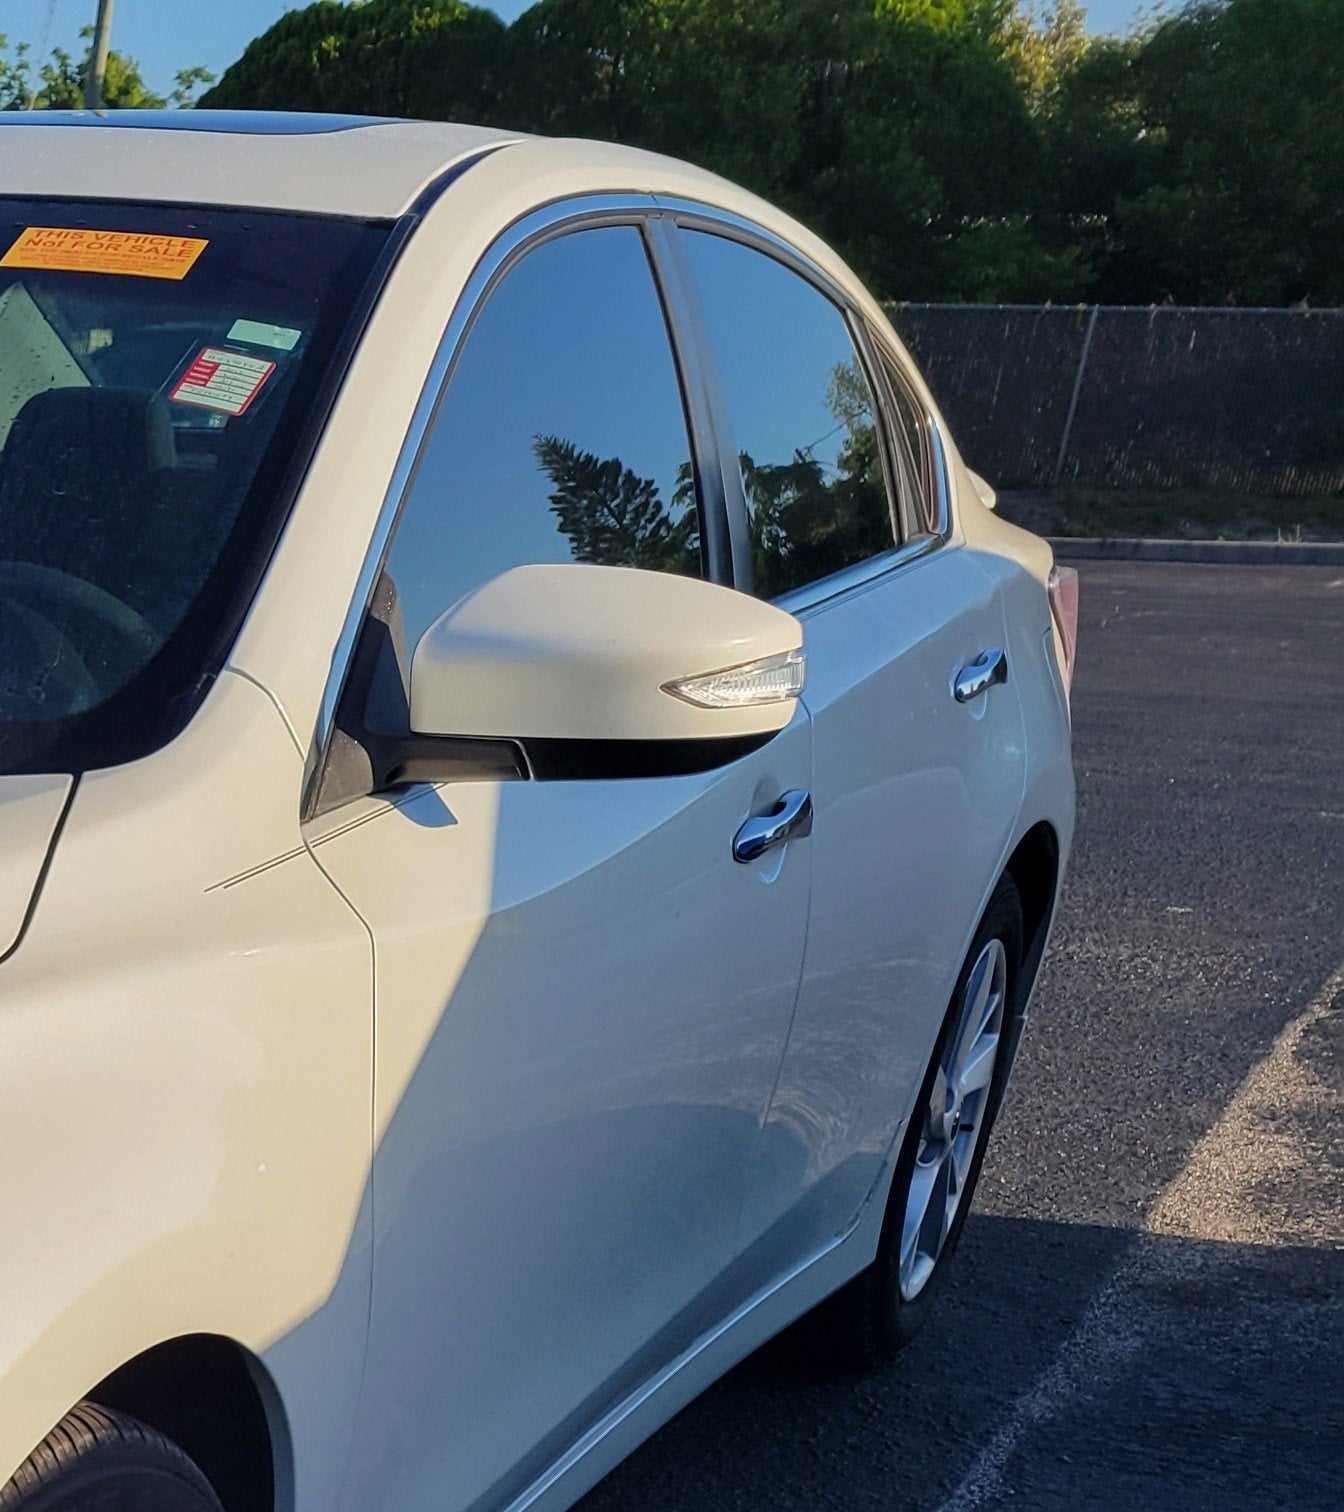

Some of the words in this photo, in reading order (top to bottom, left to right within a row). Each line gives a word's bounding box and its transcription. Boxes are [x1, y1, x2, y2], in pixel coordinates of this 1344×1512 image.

[33, 229, 84, 240] THIS
[93, 233, 197, 249] VEHICLE
[70, 239, 122, 252] FOR
[129, 244, 192, 258] SALE
